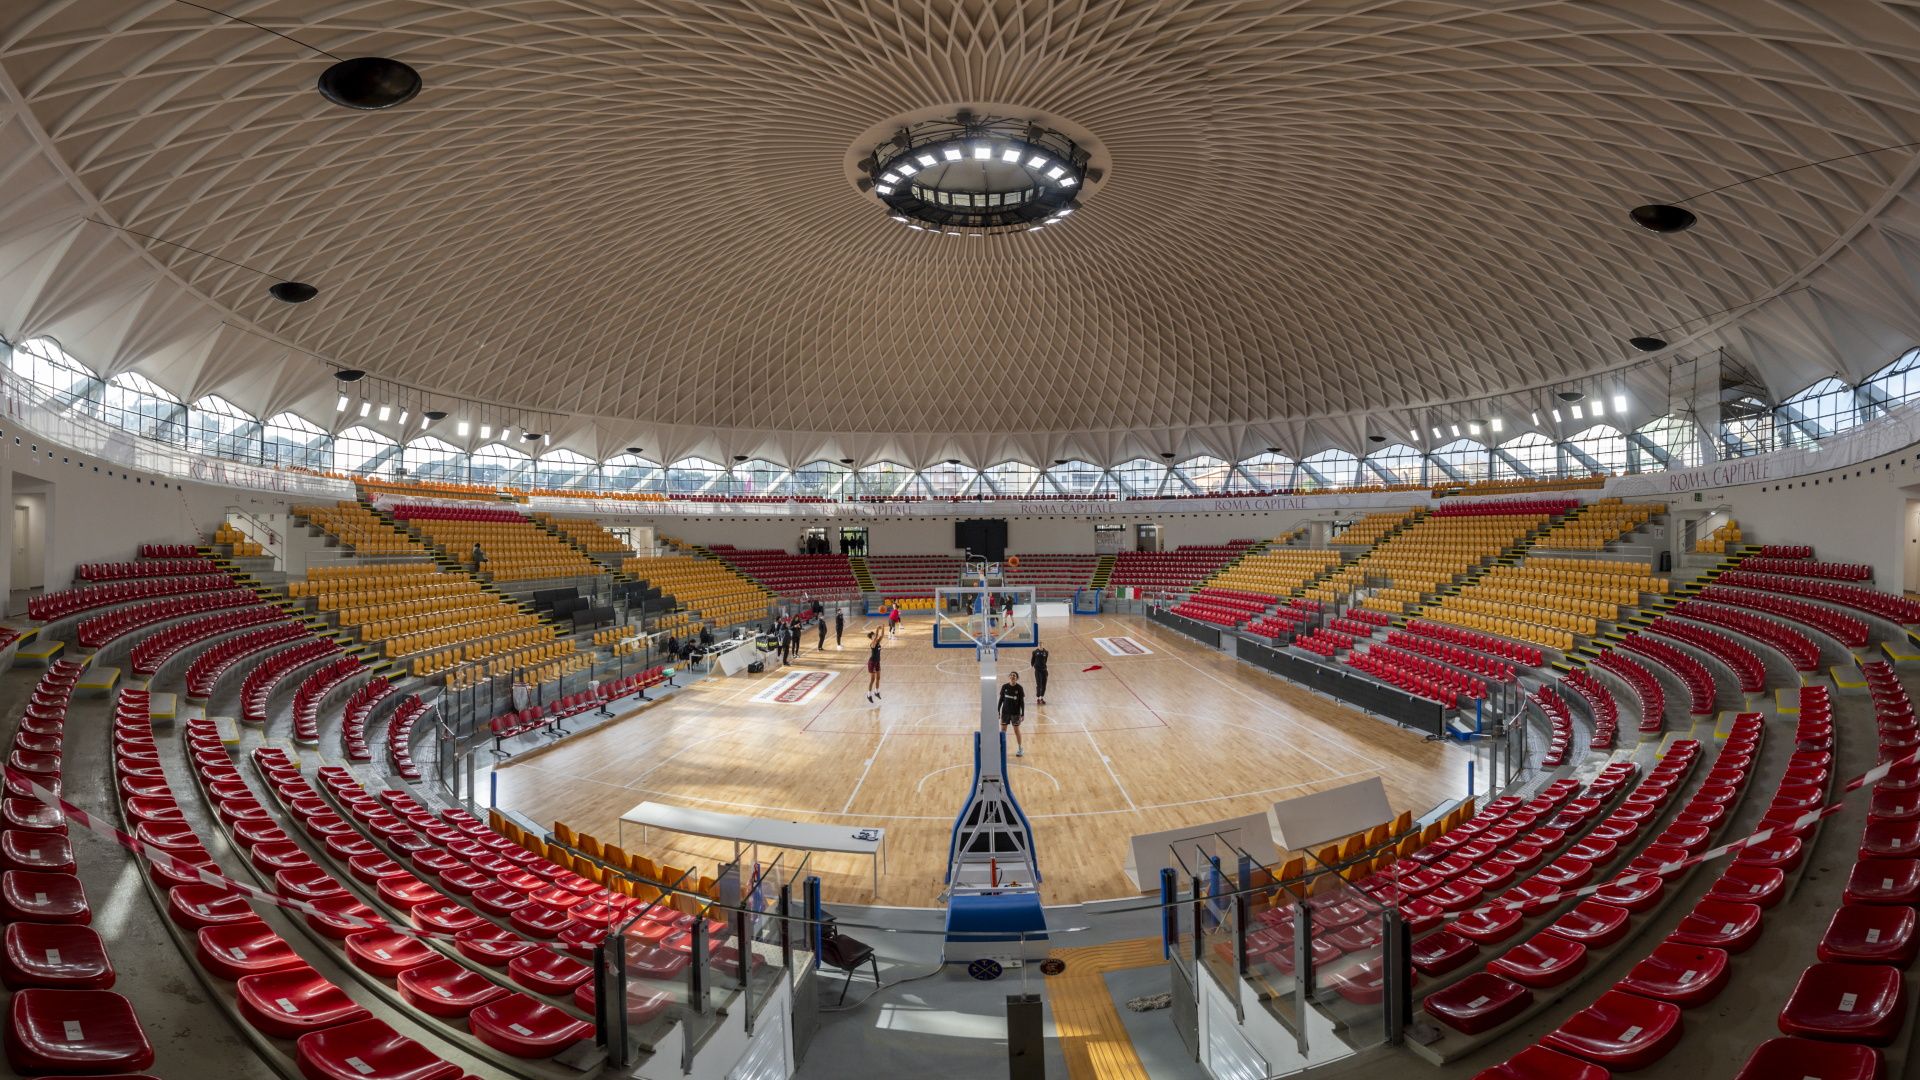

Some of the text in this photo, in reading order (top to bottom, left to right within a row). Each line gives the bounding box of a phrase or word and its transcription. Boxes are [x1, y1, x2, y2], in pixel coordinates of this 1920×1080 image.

[189, 458, 289, 492] ROMA CAPITALE
[1669, 458, 1770, 491] ROMA CAPITALE
[593, 501, 689, 514] ROMA CAPITALE
[822, 505, 913, 515] ROMA CAPITALE
[1021, 503, 1115, 514] ROMA CAPITALE
[1215, 498, 1308, 511] ROMA CAPITALE
